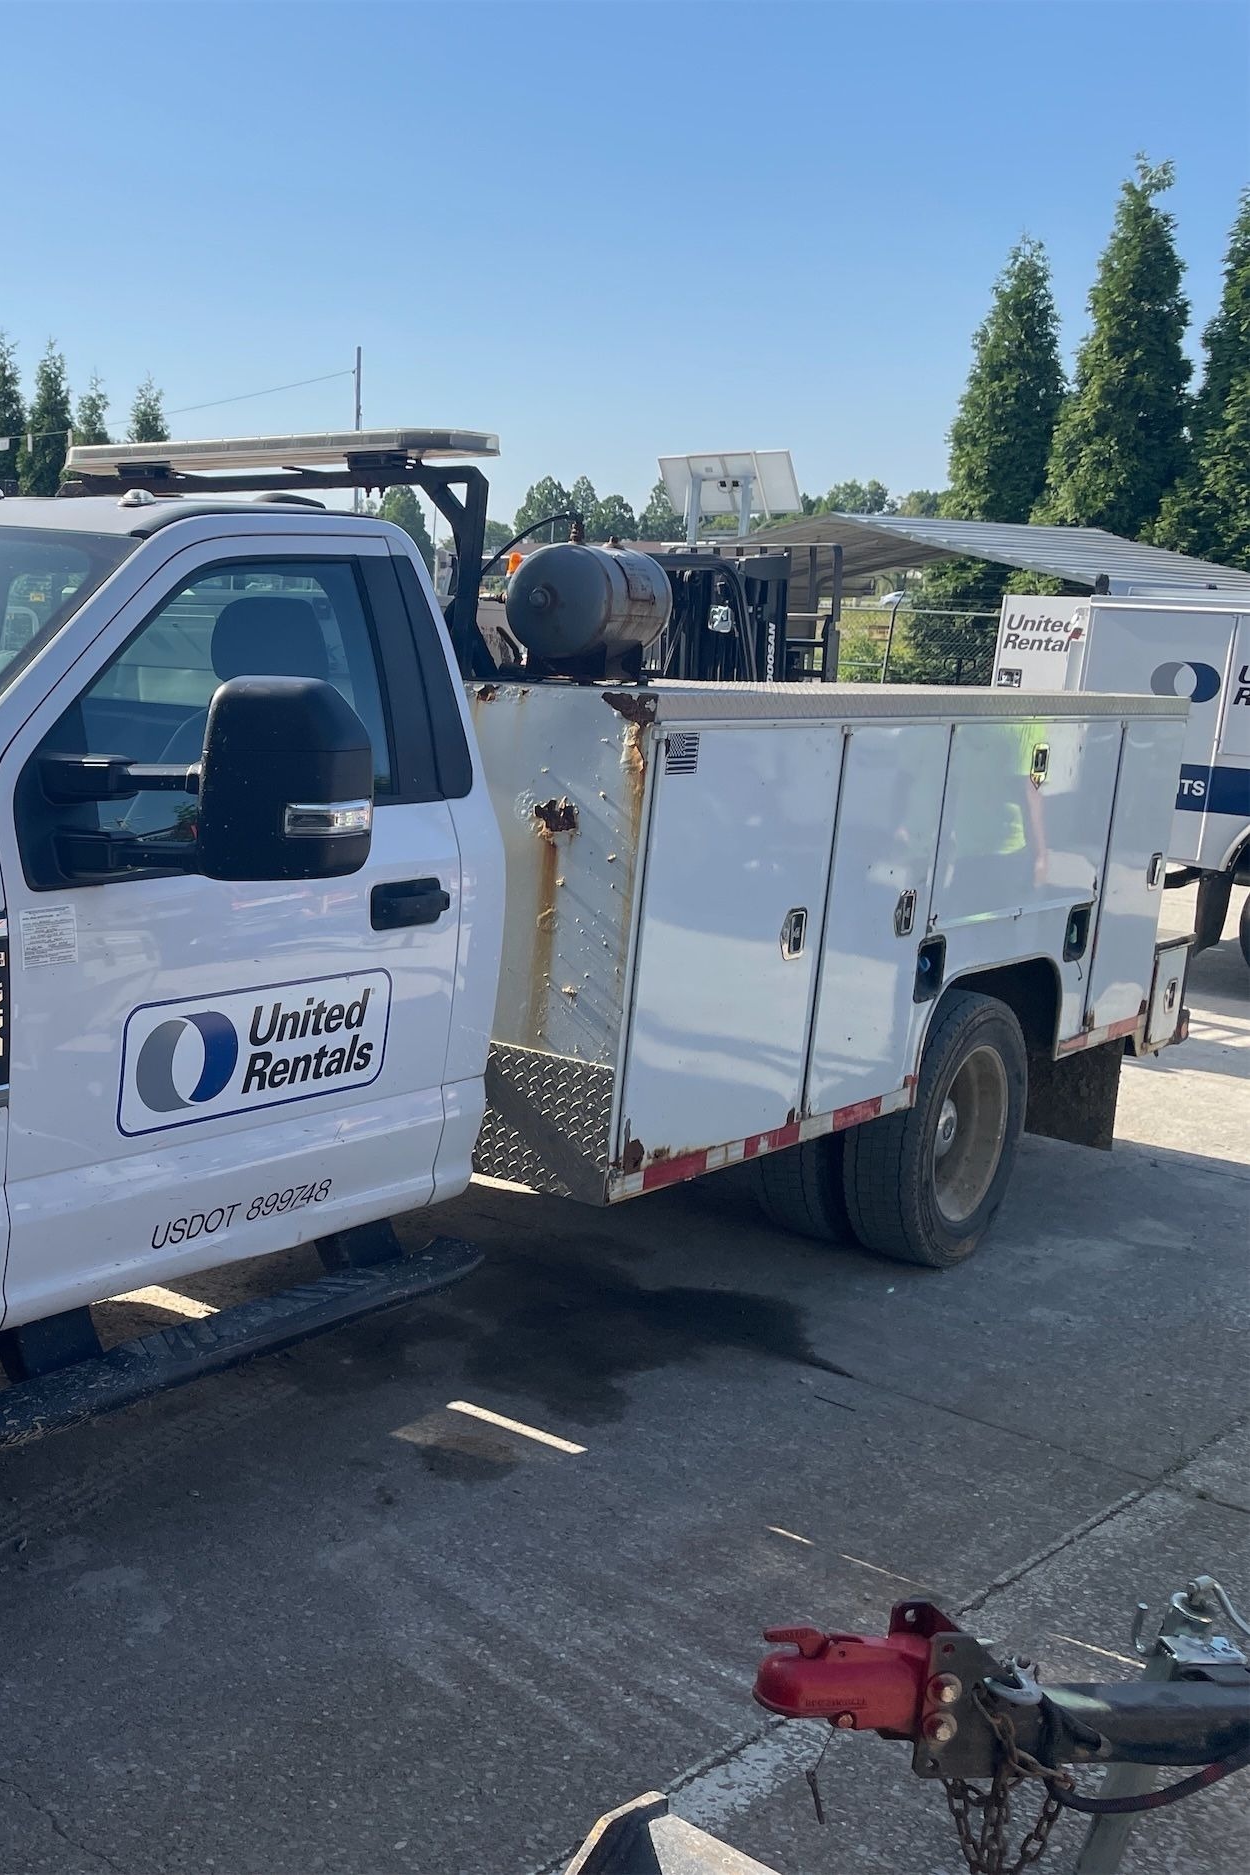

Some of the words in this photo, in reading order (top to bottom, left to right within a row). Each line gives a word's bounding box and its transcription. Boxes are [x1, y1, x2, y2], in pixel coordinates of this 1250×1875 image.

[249, 988, 371, 1047] United
[241, 1034, 374, 1095] Rentals
[151, 1202, 242, 1249] USDOT
[246, 1178, 332, 1221] 899748
